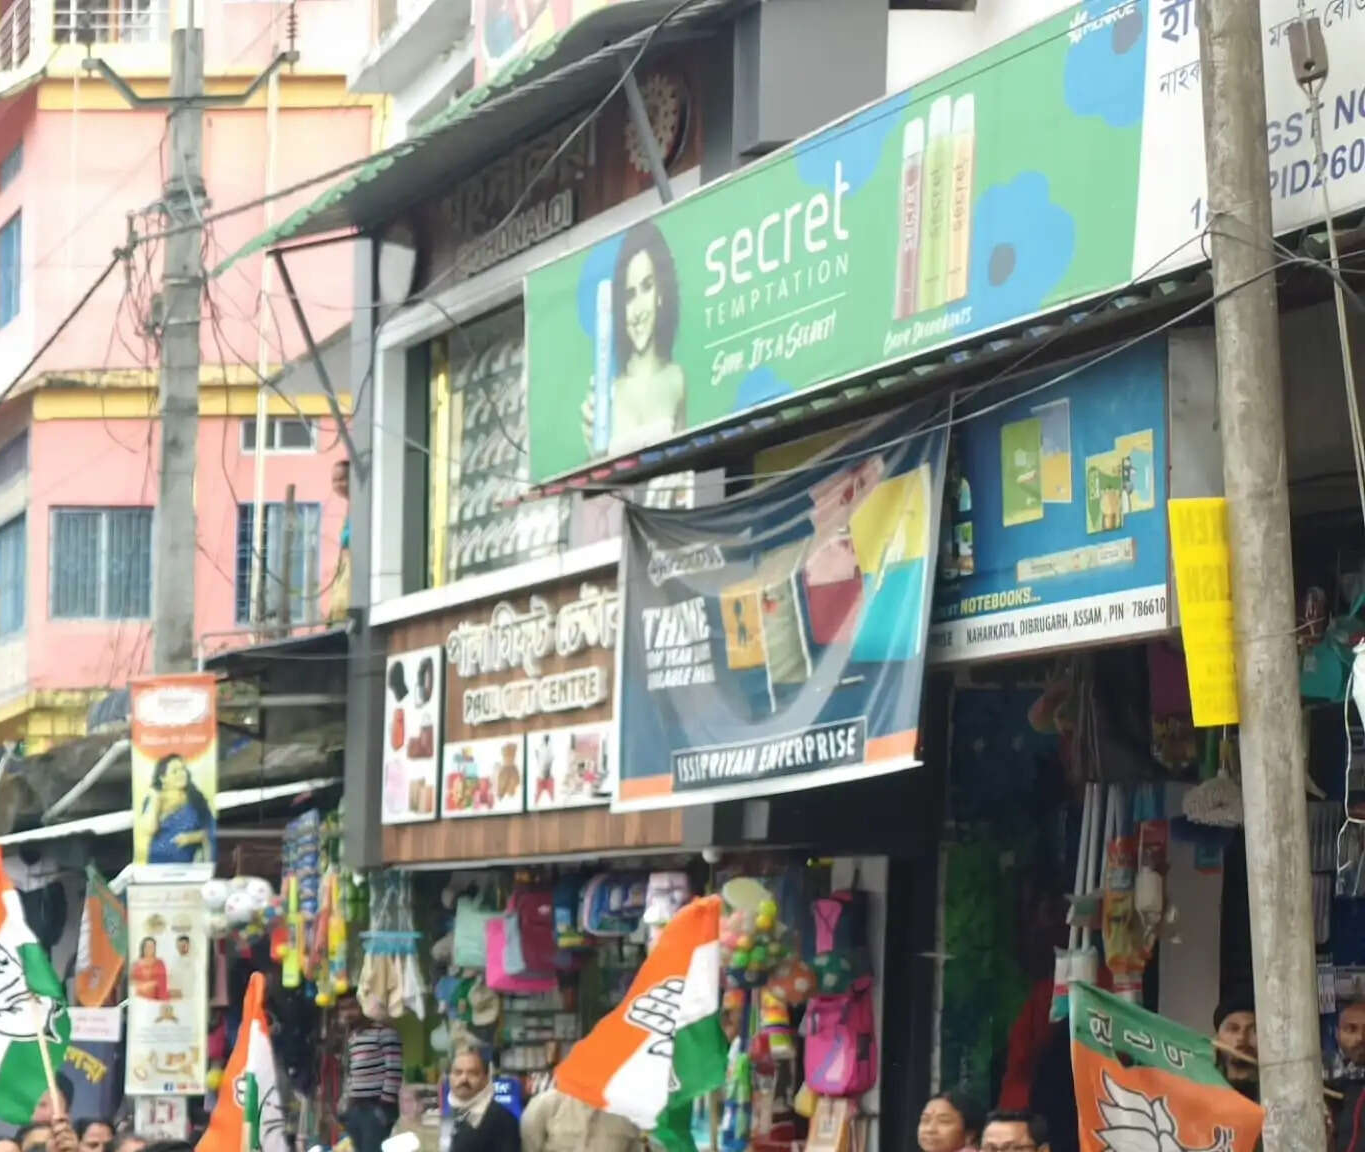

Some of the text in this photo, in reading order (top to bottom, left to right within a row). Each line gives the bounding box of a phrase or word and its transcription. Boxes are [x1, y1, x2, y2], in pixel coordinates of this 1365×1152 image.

[705, 160, 850, 297] secret
[705, 253, 850, 329] TEMPTATION
[1131, 595, 1167, 619] 786610
[540, 669, 600, 711] CENTRE
[758, 726, 858, 772] ENTERPRISE
